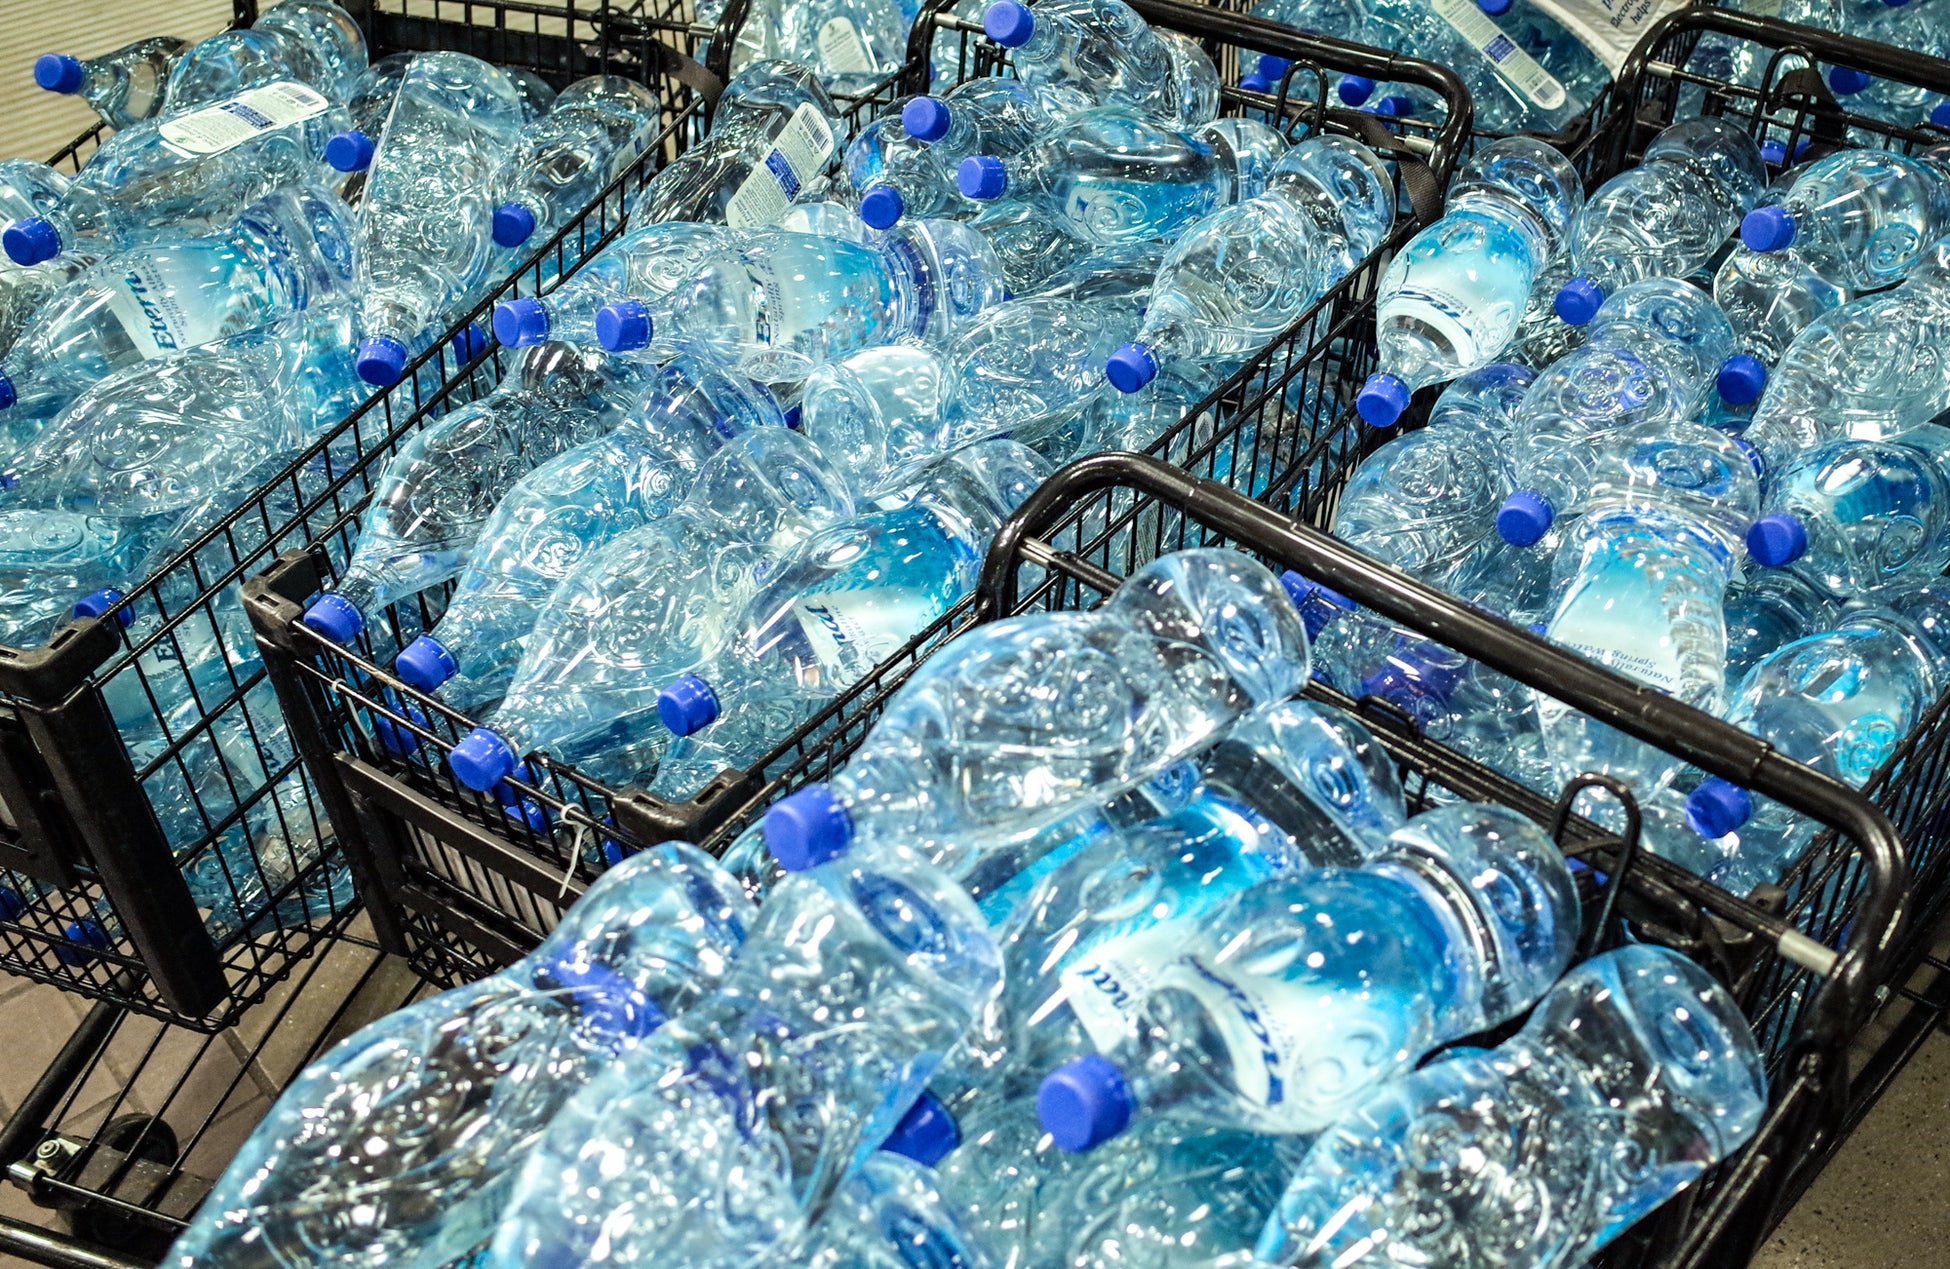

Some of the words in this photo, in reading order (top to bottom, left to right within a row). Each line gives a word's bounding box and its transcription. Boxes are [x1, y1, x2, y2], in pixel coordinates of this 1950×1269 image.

[1610, 0, 1640, 28] Electro
[1630, 1, 1651, 24] helps
[1612, 649, 1657, 669] Spring
